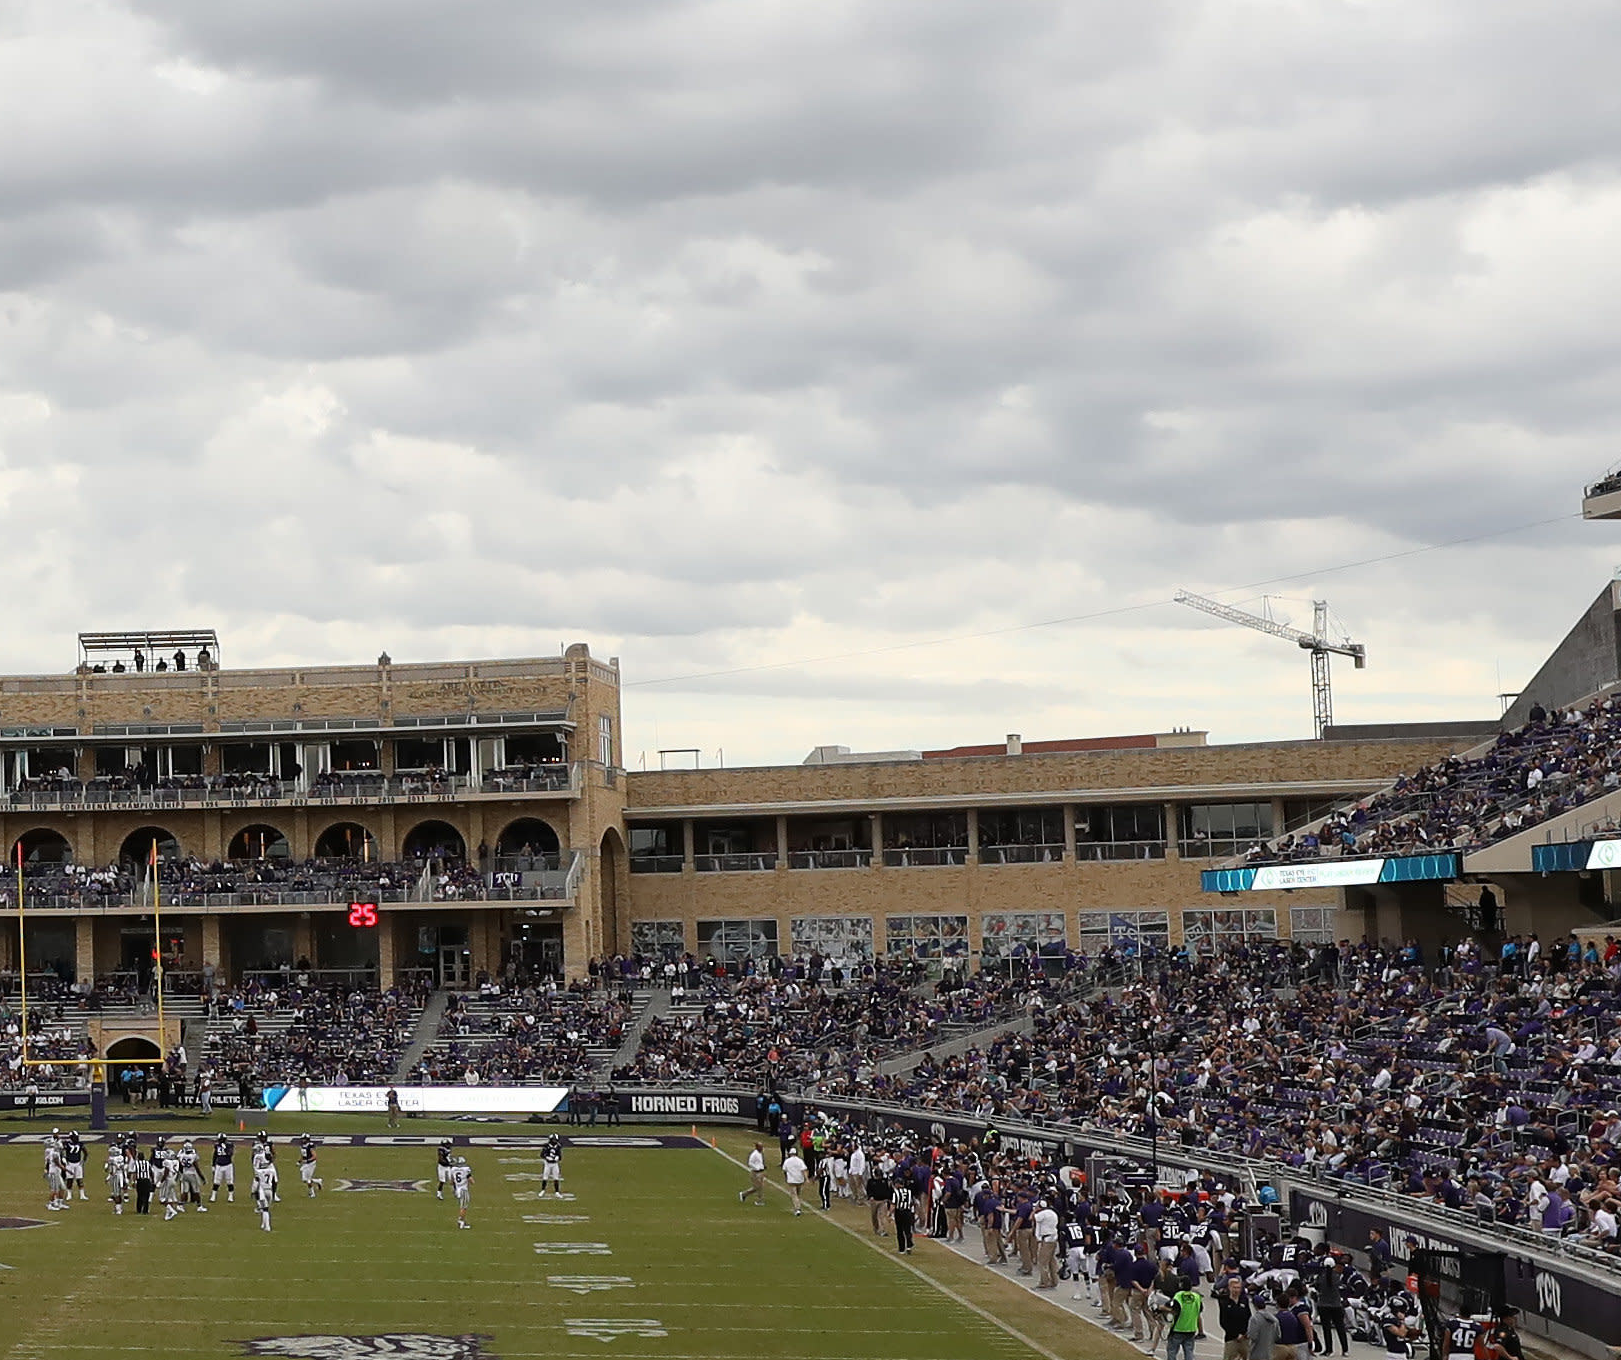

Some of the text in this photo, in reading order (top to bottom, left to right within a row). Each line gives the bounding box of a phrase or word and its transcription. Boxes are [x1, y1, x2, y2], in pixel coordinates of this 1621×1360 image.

[348, 901, 378, 927] 25
[631, 1096, 739, 1114] HORNED FROGS
[69, 1144, 81, 1154] 77
[1069, 1225, 1084, 1240] 16
[1282, 1247, 1295, 1262] 12
[1535, 1271, 1562, 1319] TCU
[1451, 1327, 1476, 1349] 46
